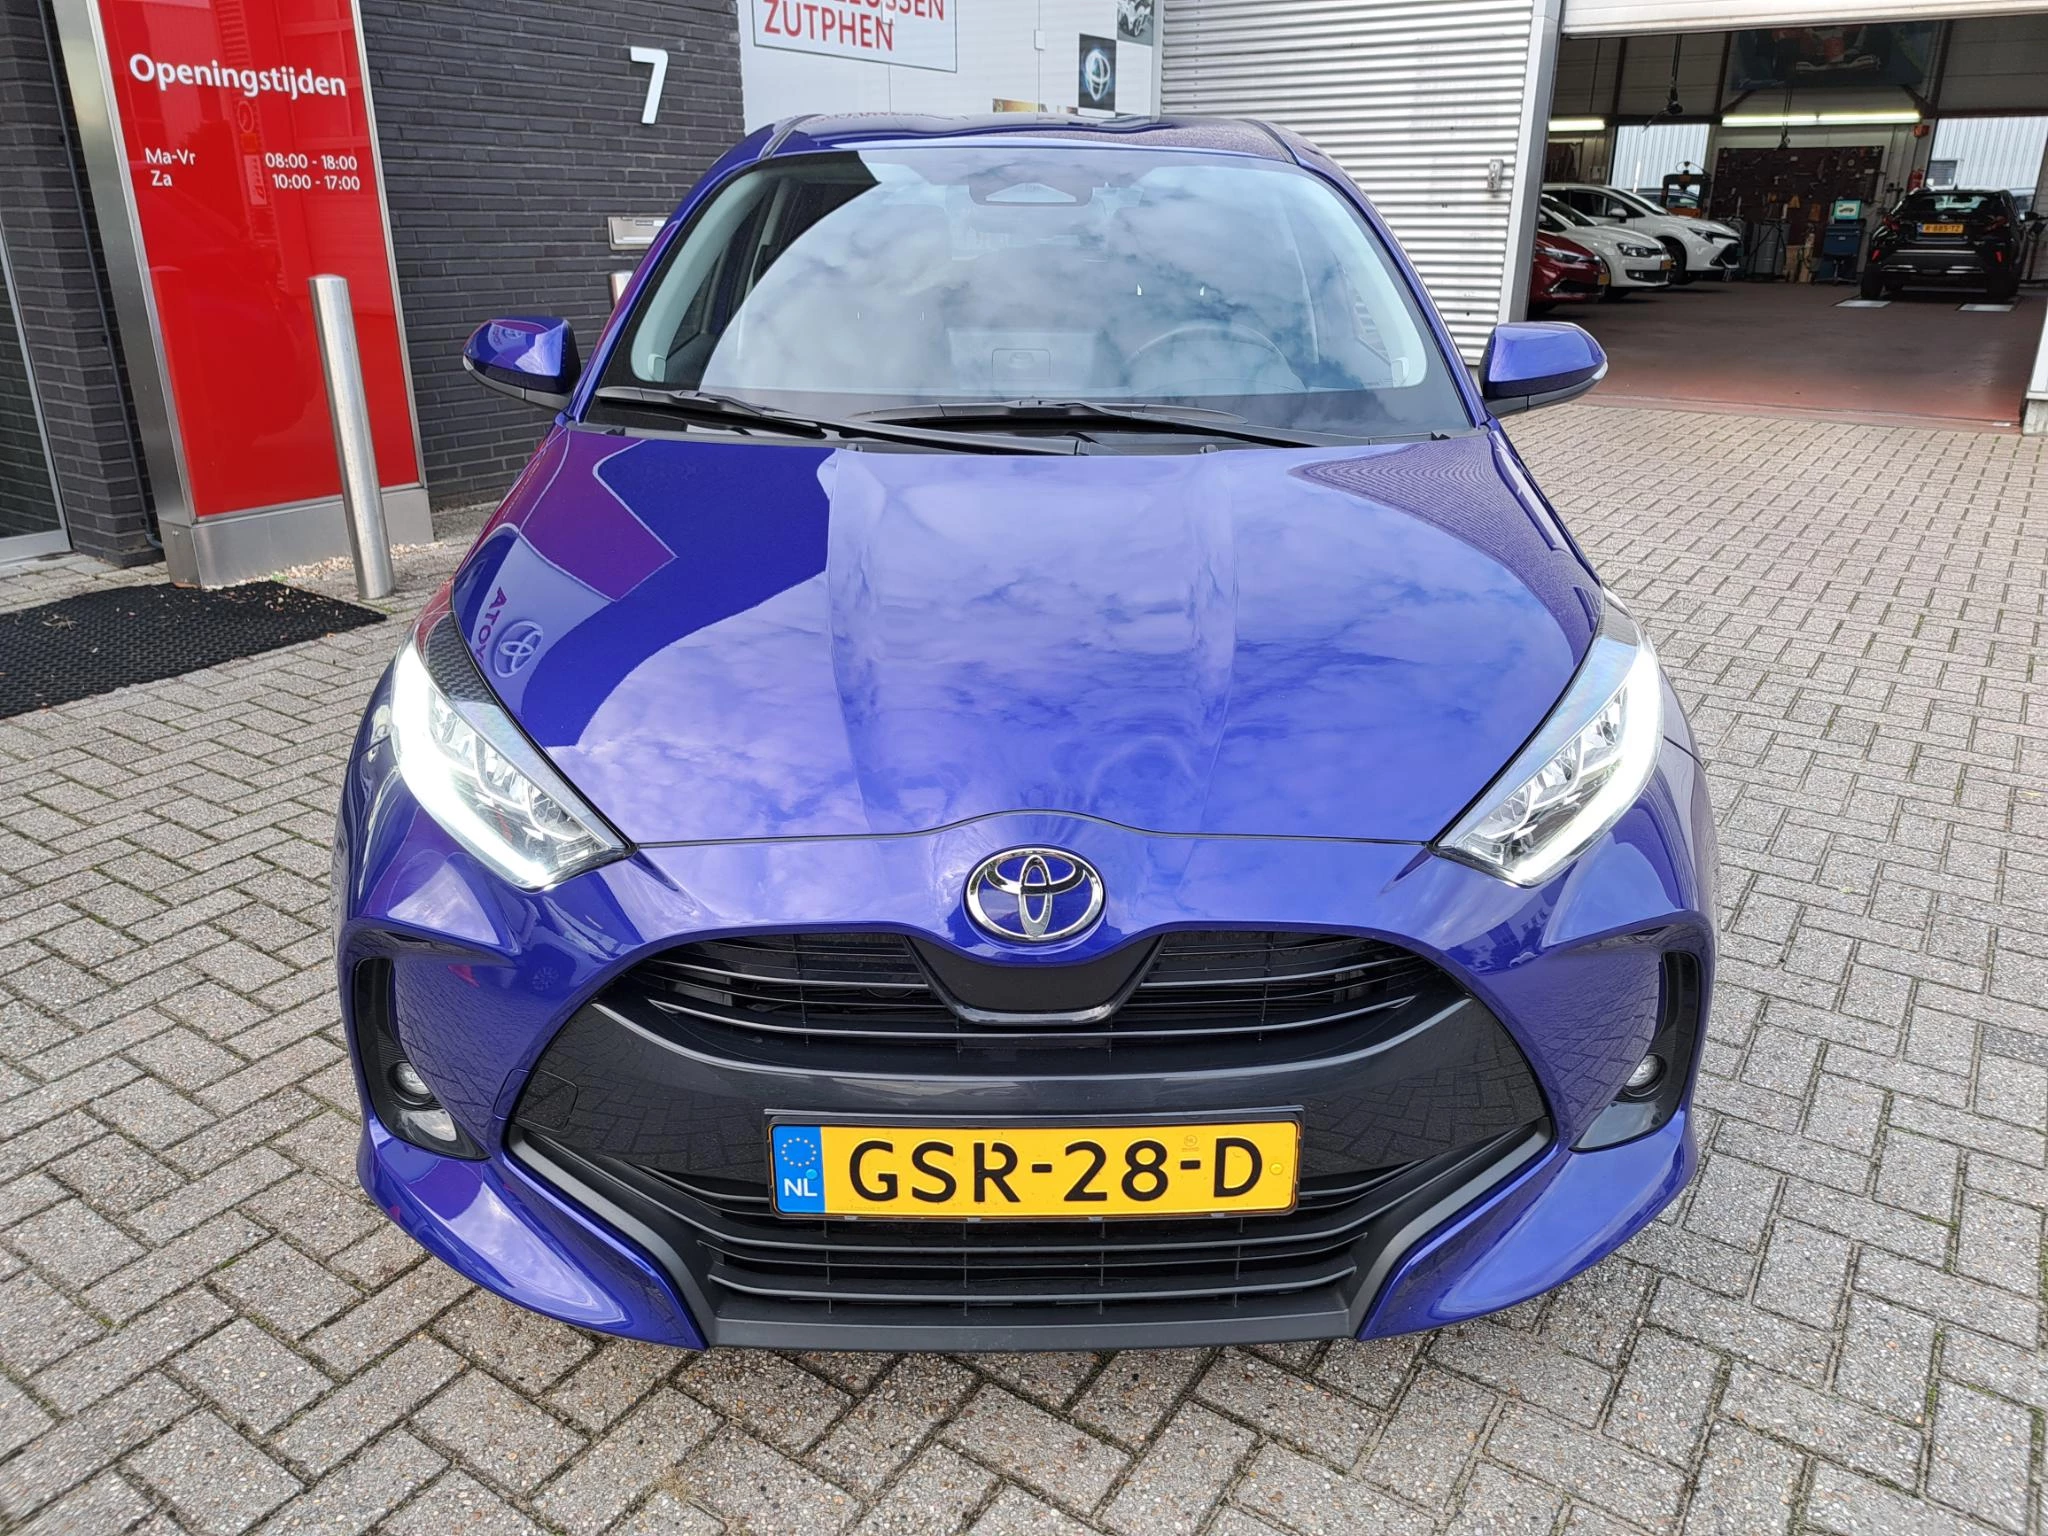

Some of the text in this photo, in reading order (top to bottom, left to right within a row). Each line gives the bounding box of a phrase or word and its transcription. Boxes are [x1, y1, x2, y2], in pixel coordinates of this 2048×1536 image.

[764, 0, 893, 51] ZUTPHEN
[129, 53, 346, 100] Openingstijden
[630, 46, 668, 124] 7
[145, 147, 196, 166] Ma-Vr
[265, 152, 308, 169] 08:00
[321, 154, 358, 171] 18:00
[151, 170, 173, 187] Za
[272, 173, 311, 190] 10:00
[324, 175, 360, 191] 17:00
[784, 1177, 818, 1198] NL
[849, 1137, 1263, 1203] GSR-28-D
